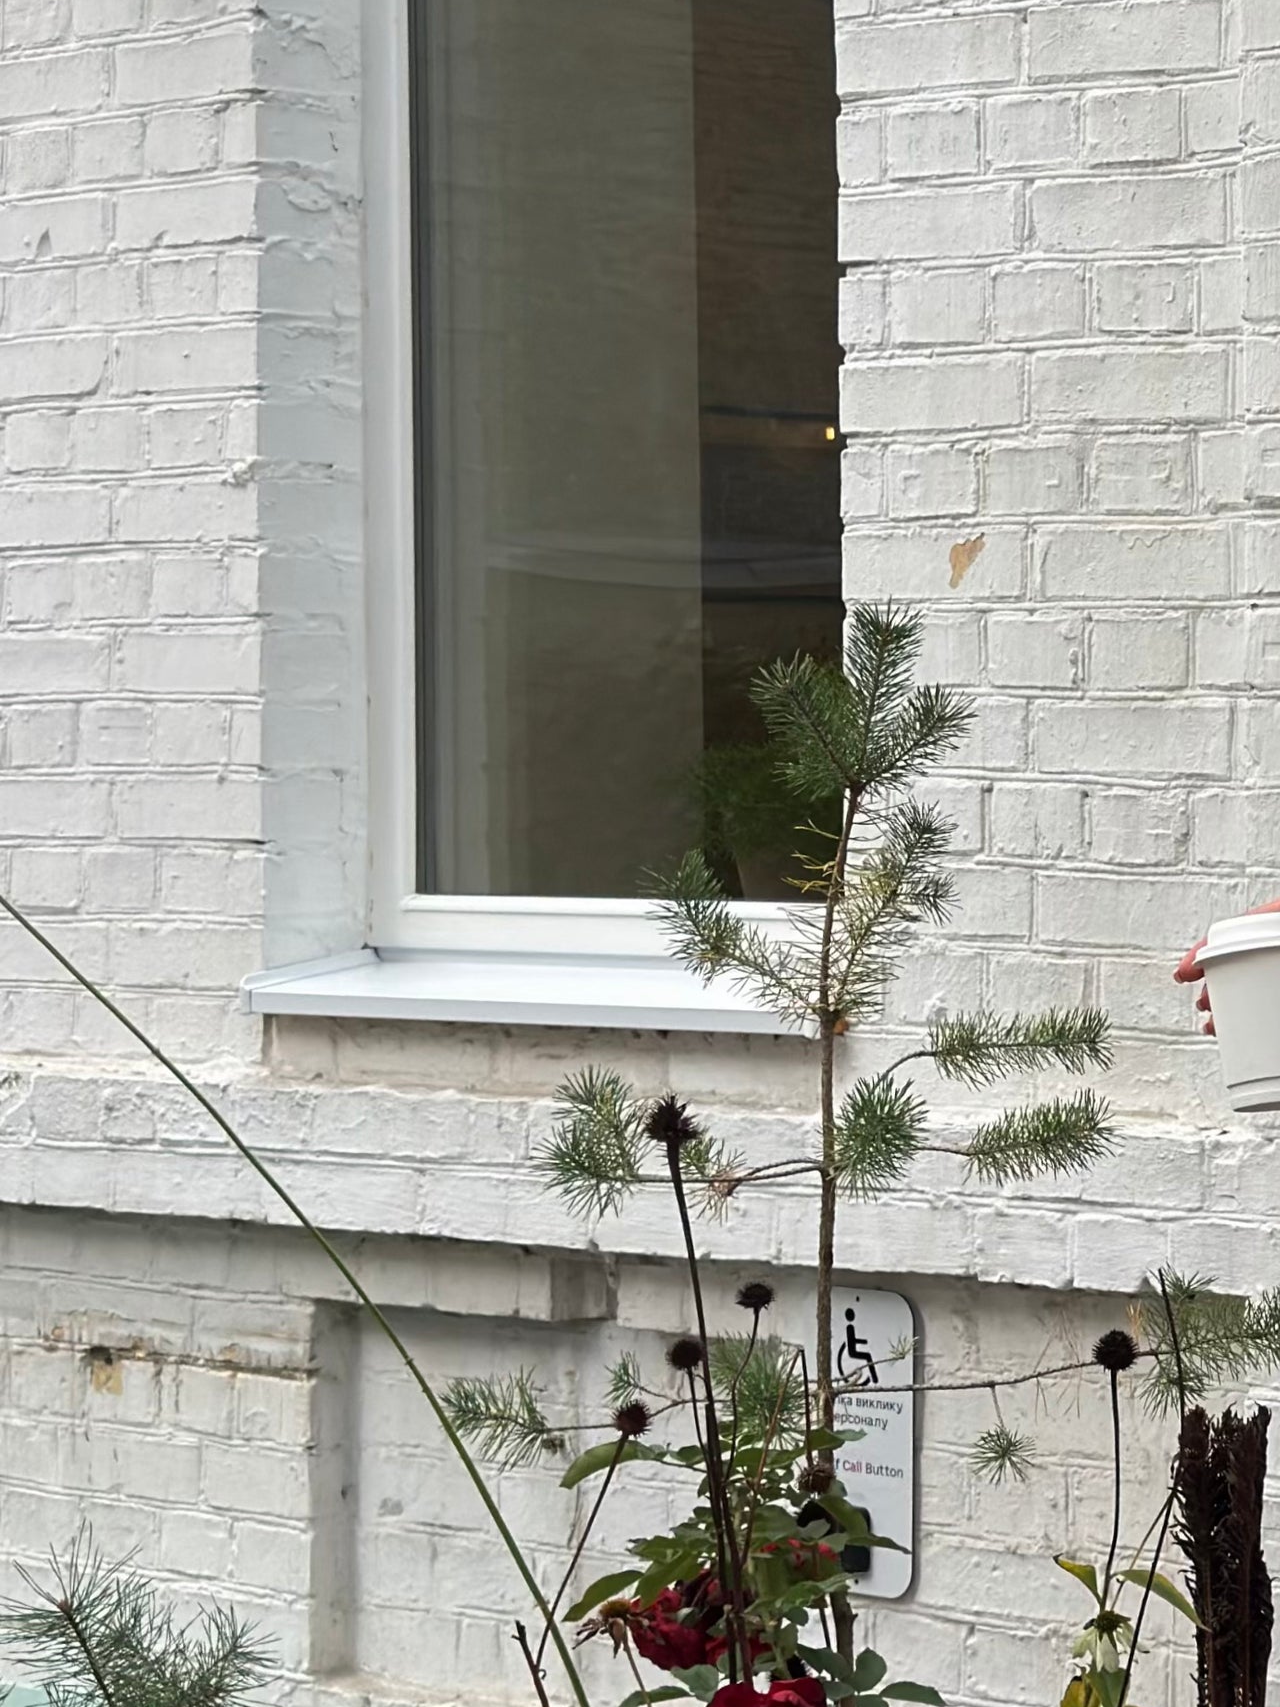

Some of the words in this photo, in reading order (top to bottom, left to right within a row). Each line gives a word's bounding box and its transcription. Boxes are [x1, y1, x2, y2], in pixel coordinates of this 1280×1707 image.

[855, 1396, 904, 1415] виклику
[833, 1413, 889, 1431] ерсоналу
[842, 1459, 863, 1473] Call
[865, 1462, 905, 1479] Button
